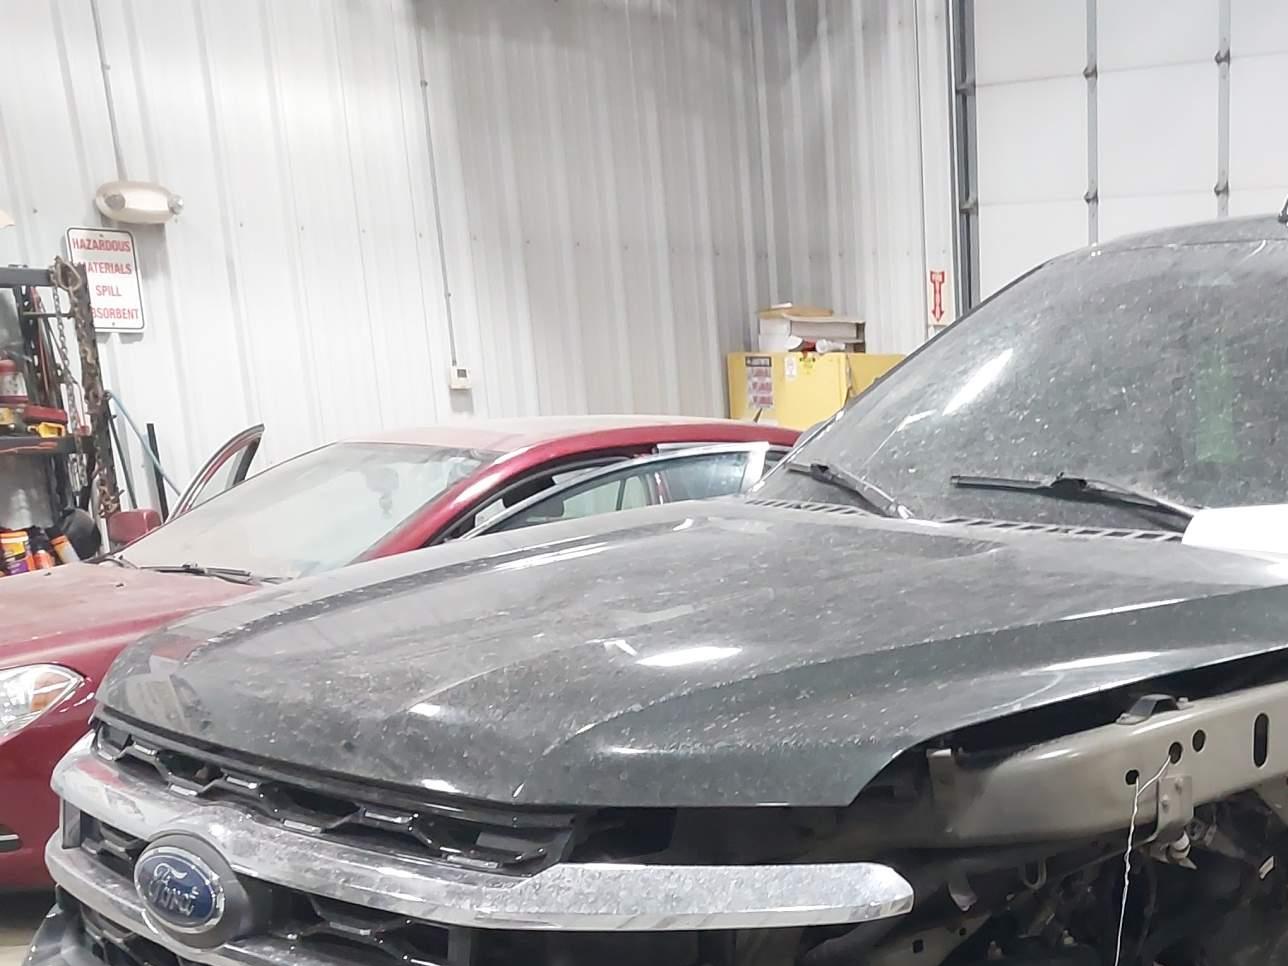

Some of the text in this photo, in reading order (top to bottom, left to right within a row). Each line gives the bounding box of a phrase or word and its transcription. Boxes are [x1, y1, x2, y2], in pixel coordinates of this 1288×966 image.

[72, 238, 131, 252] HAZARDOUS
[85, 262, 132, 274] ATERIALS
[95, 284, 122, 297] SPILL
[91, 307, 139, 320] BSORBENT
[149, 862, 200, 916] Ford
